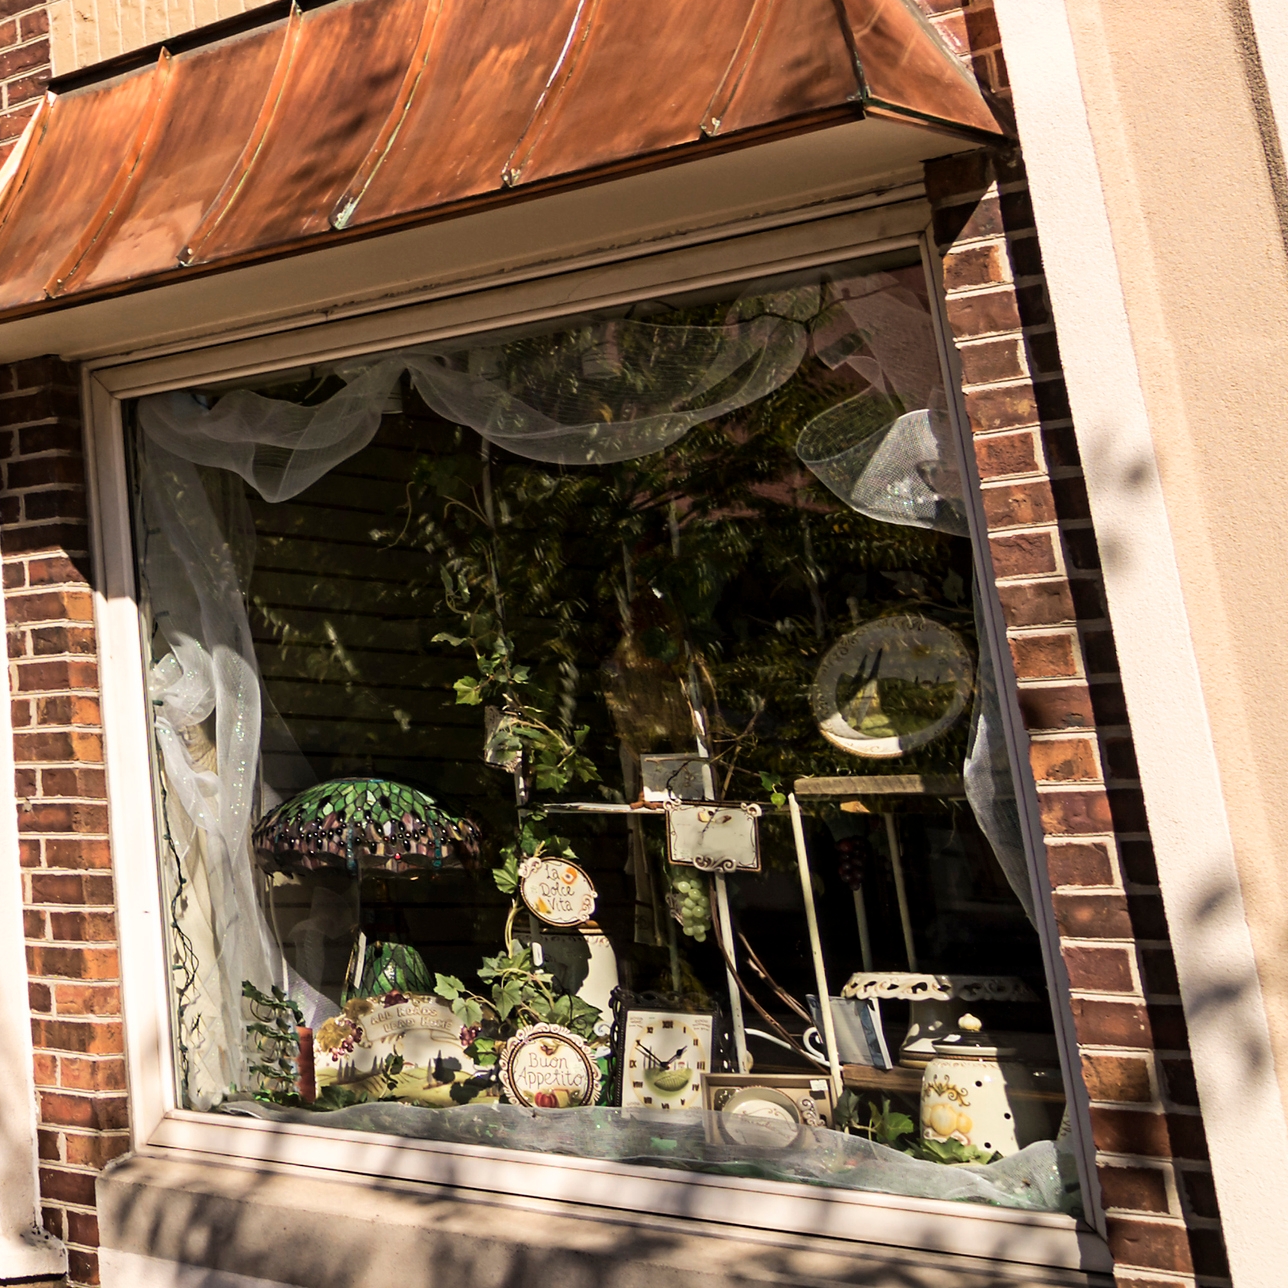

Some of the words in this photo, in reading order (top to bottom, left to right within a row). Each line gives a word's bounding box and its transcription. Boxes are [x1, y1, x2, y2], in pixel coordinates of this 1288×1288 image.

[546, 864, 560, 881] La
[539, 882, 575, 897] Dolce
[547, 897, 573, 912] Vita
[370, 1011, 393, 1025] ALL
[396, 1006, 438, 1018] ROADS
[383, 1017, 416, 1032] LEAD
[528, 1053, 568, 1069] Buon
[515, 1067, 584, 1089] Appetito
